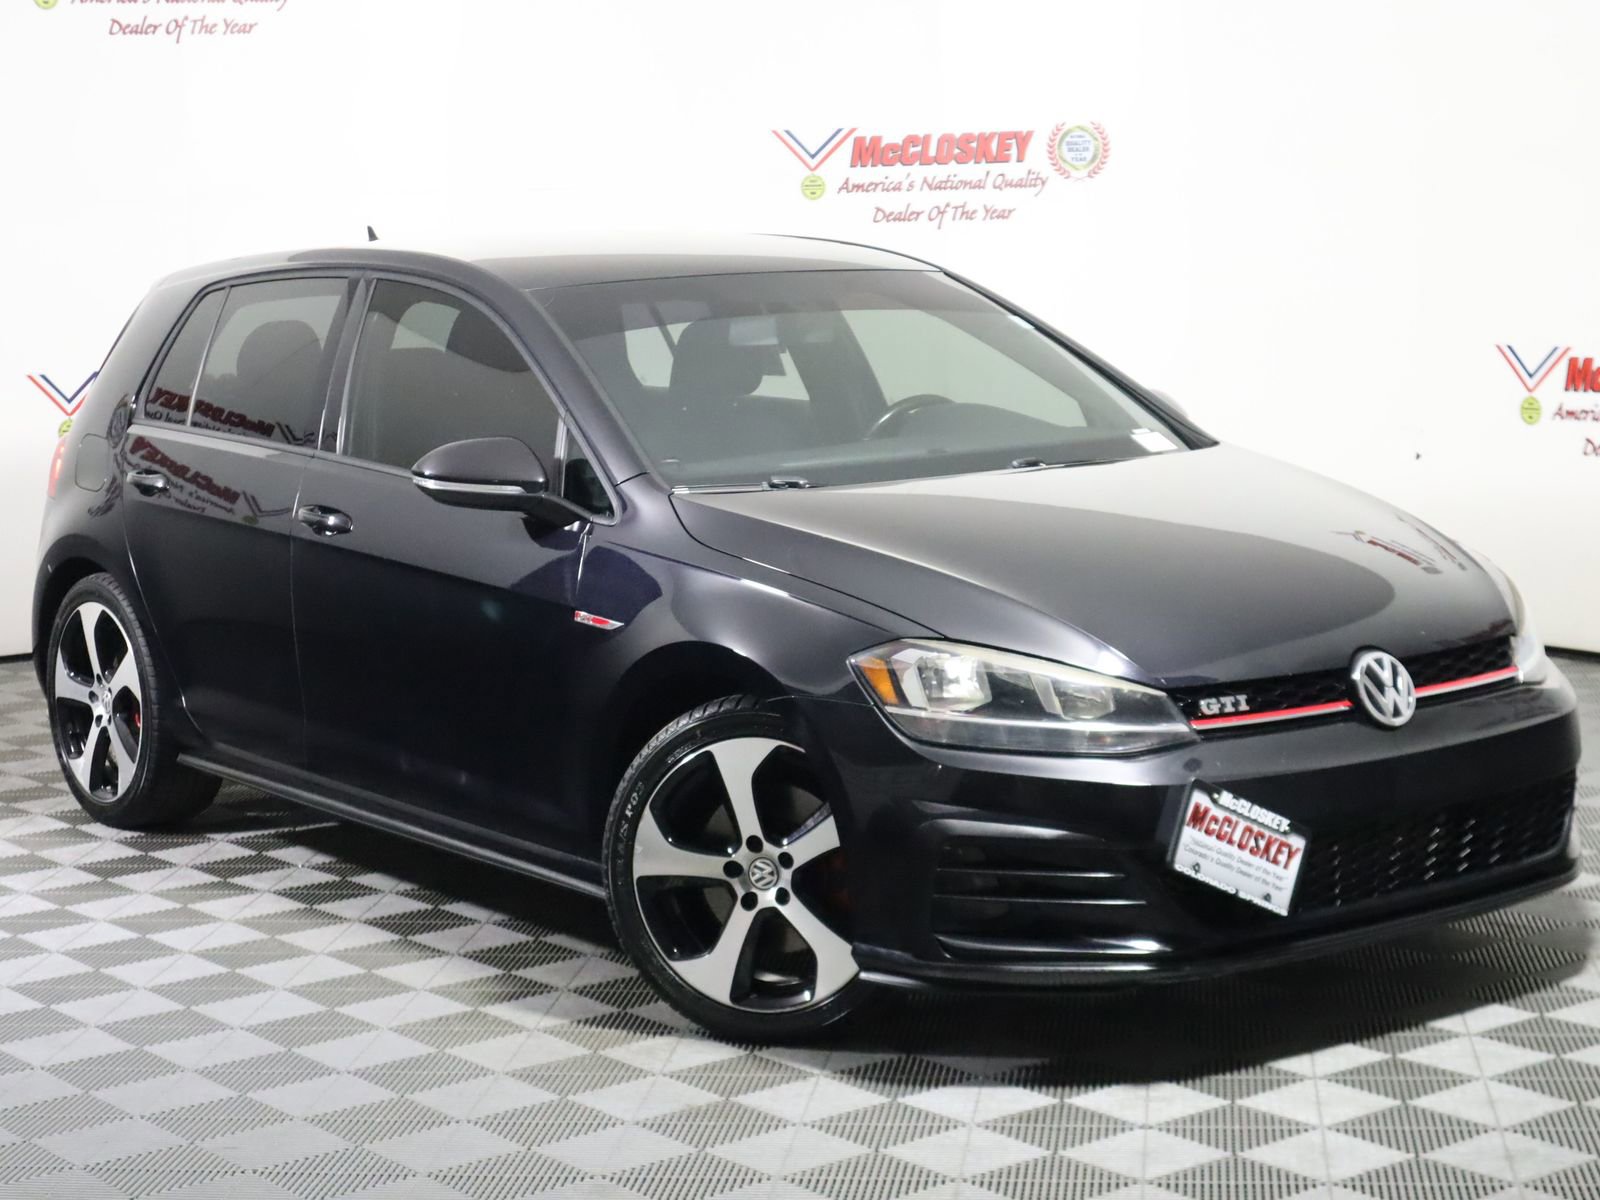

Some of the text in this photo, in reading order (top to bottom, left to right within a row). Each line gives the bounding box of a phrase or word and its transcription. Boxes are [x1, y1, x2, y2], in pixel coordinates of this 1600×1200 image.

[108, 14, 259, 44] Dealer Of The Year
[849, 130, 1035, 168] McCLOSKEY
[837, 172, 915, 194] America's
[919, 171, 991, 192] National
[992, 168, 1049, 197] Quality
[873, 201, 1017, 230] Dealer Of The Year
[1199, 694, 1251, 716] GTI
[1218, 789, 1291, 833] McCLOSKEY
[1185, 801, 1303, 871] McCLOSKEY
